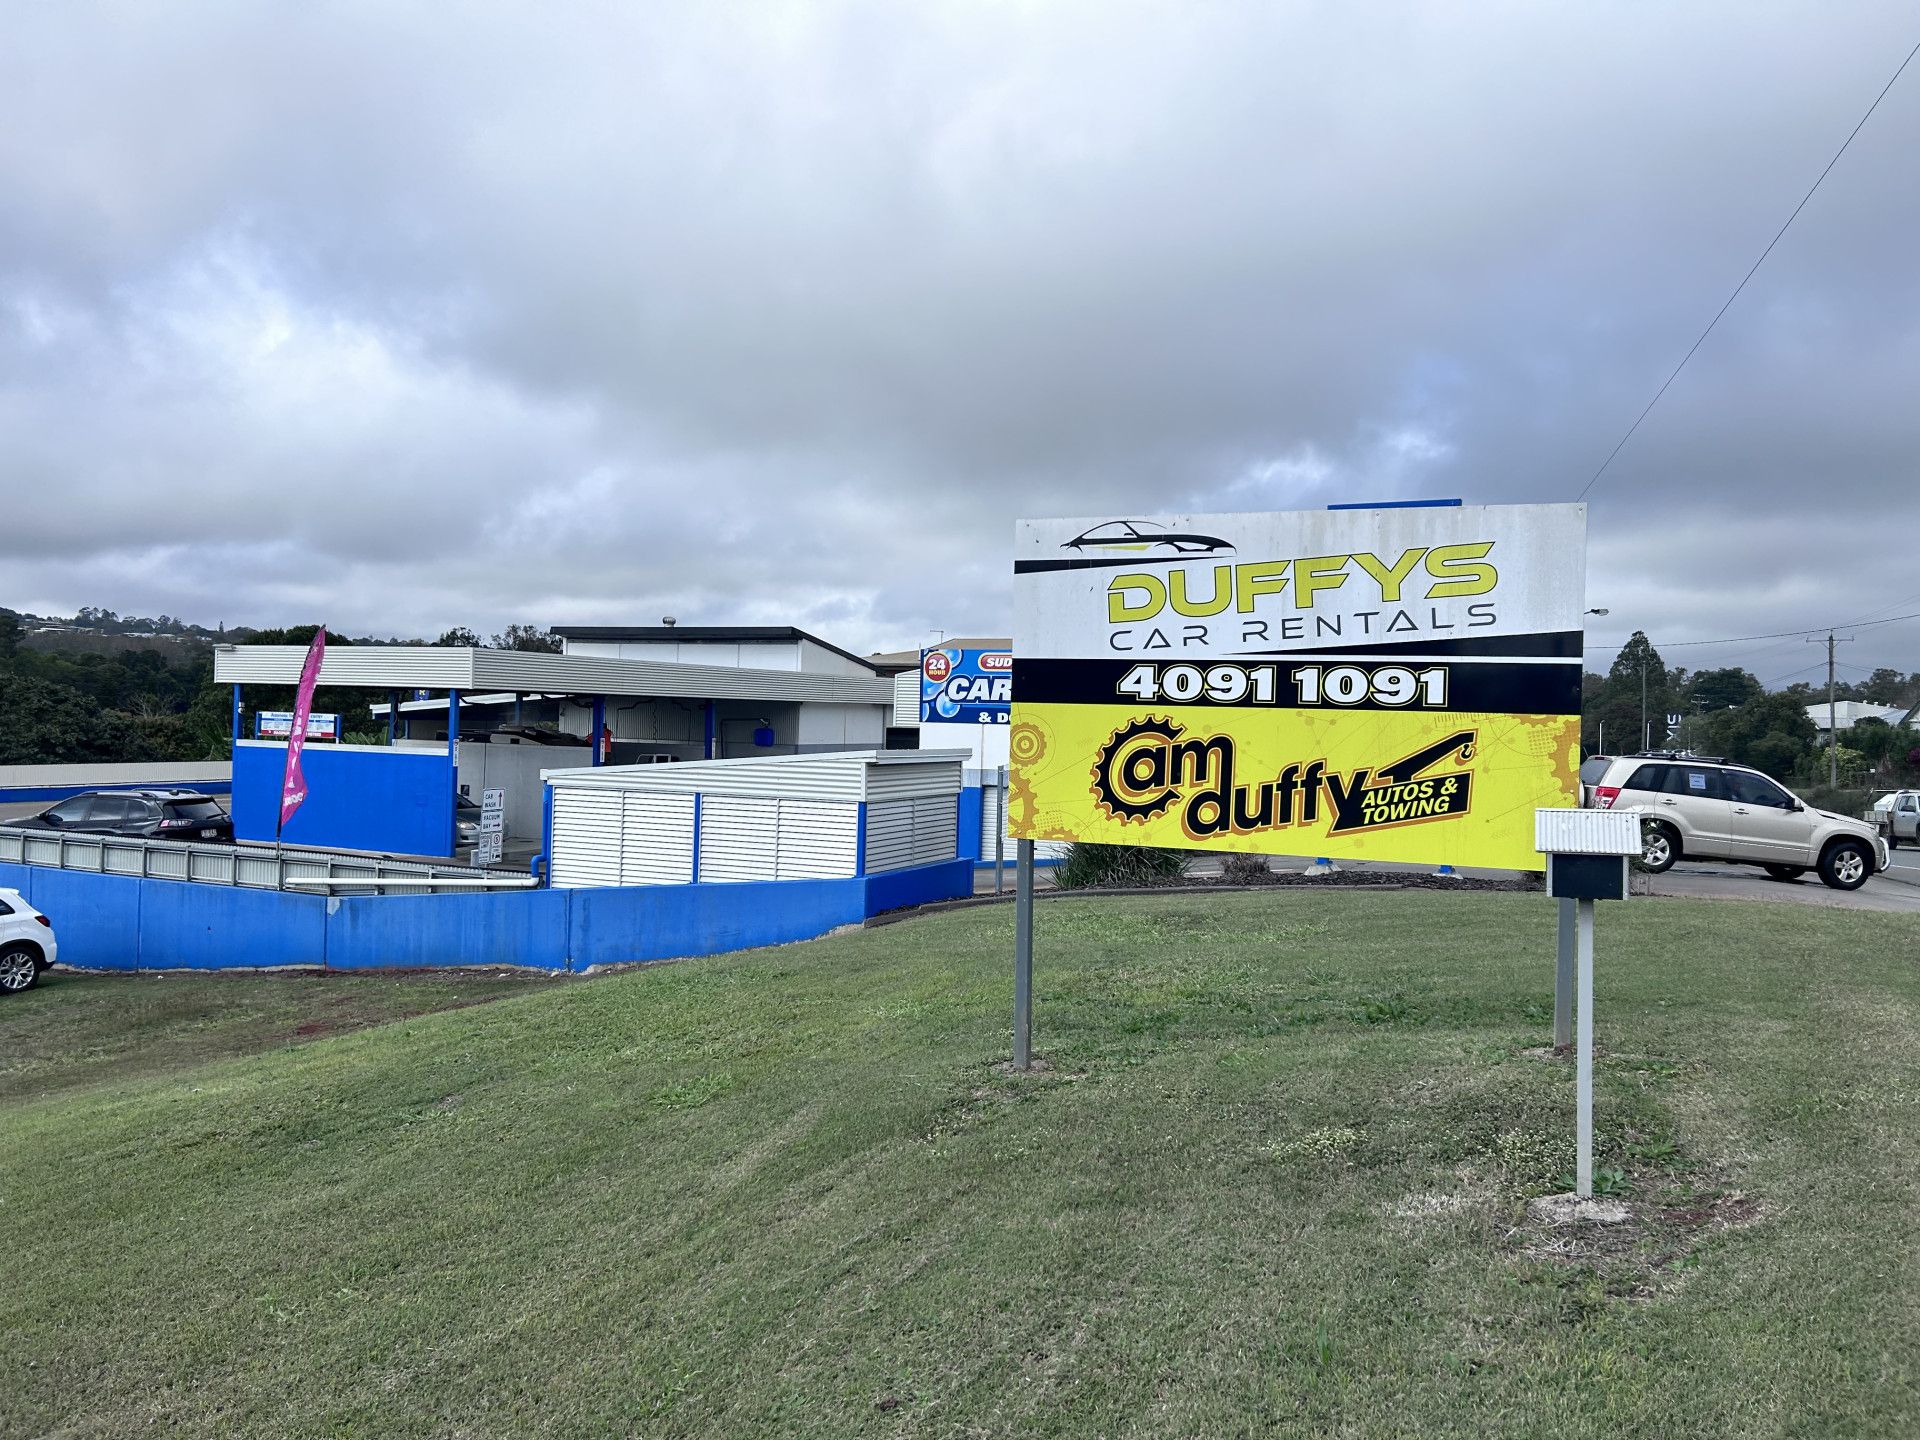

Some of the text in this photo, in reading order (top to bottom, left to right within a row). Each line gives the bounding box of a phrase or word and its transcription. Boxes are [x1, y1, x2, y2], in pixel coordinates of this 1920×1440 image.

[1107, 541, 1498, 623] DUFFYS
[1109, 603, 1497, 651] CAR RENTALS
[928, 658, 946, 670] 24
[947, 677, 1012, 701] CAR
[1117, 663, 1449, 708] 4091 1091
[978, 711, 1010, 723] & D
[1181, 757, 1375, 841] duffy
[1361, 777, 1458, 808] AUTOS &
[1362, 796, 1450, 825] TOWING
